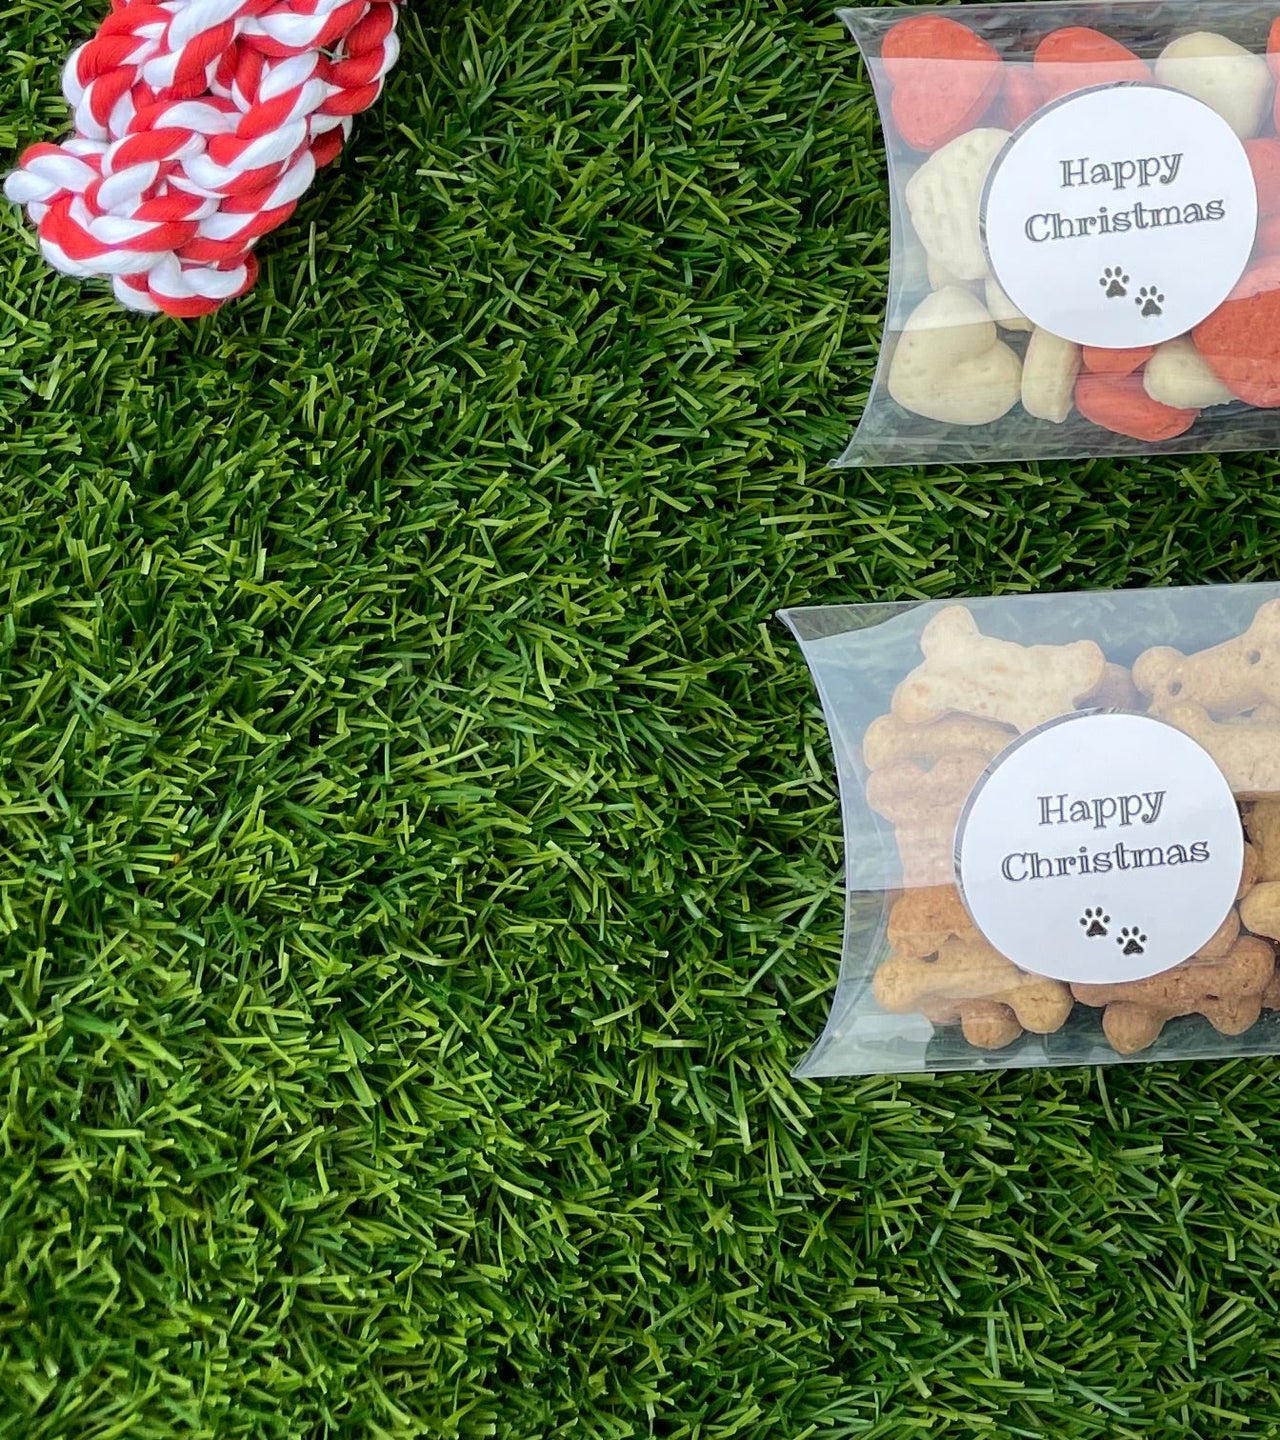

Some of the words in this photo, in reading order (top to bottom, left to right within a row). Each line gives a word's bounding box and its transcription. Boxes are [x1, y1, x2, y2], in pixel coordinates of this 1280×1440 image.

[1059, 152, 1183, 190] Happy
[1024, 199, 1225, 242] Christmas
[1038, 789, 1166, 829] Happy
[1000, 840, 1210, 882] Christmas
